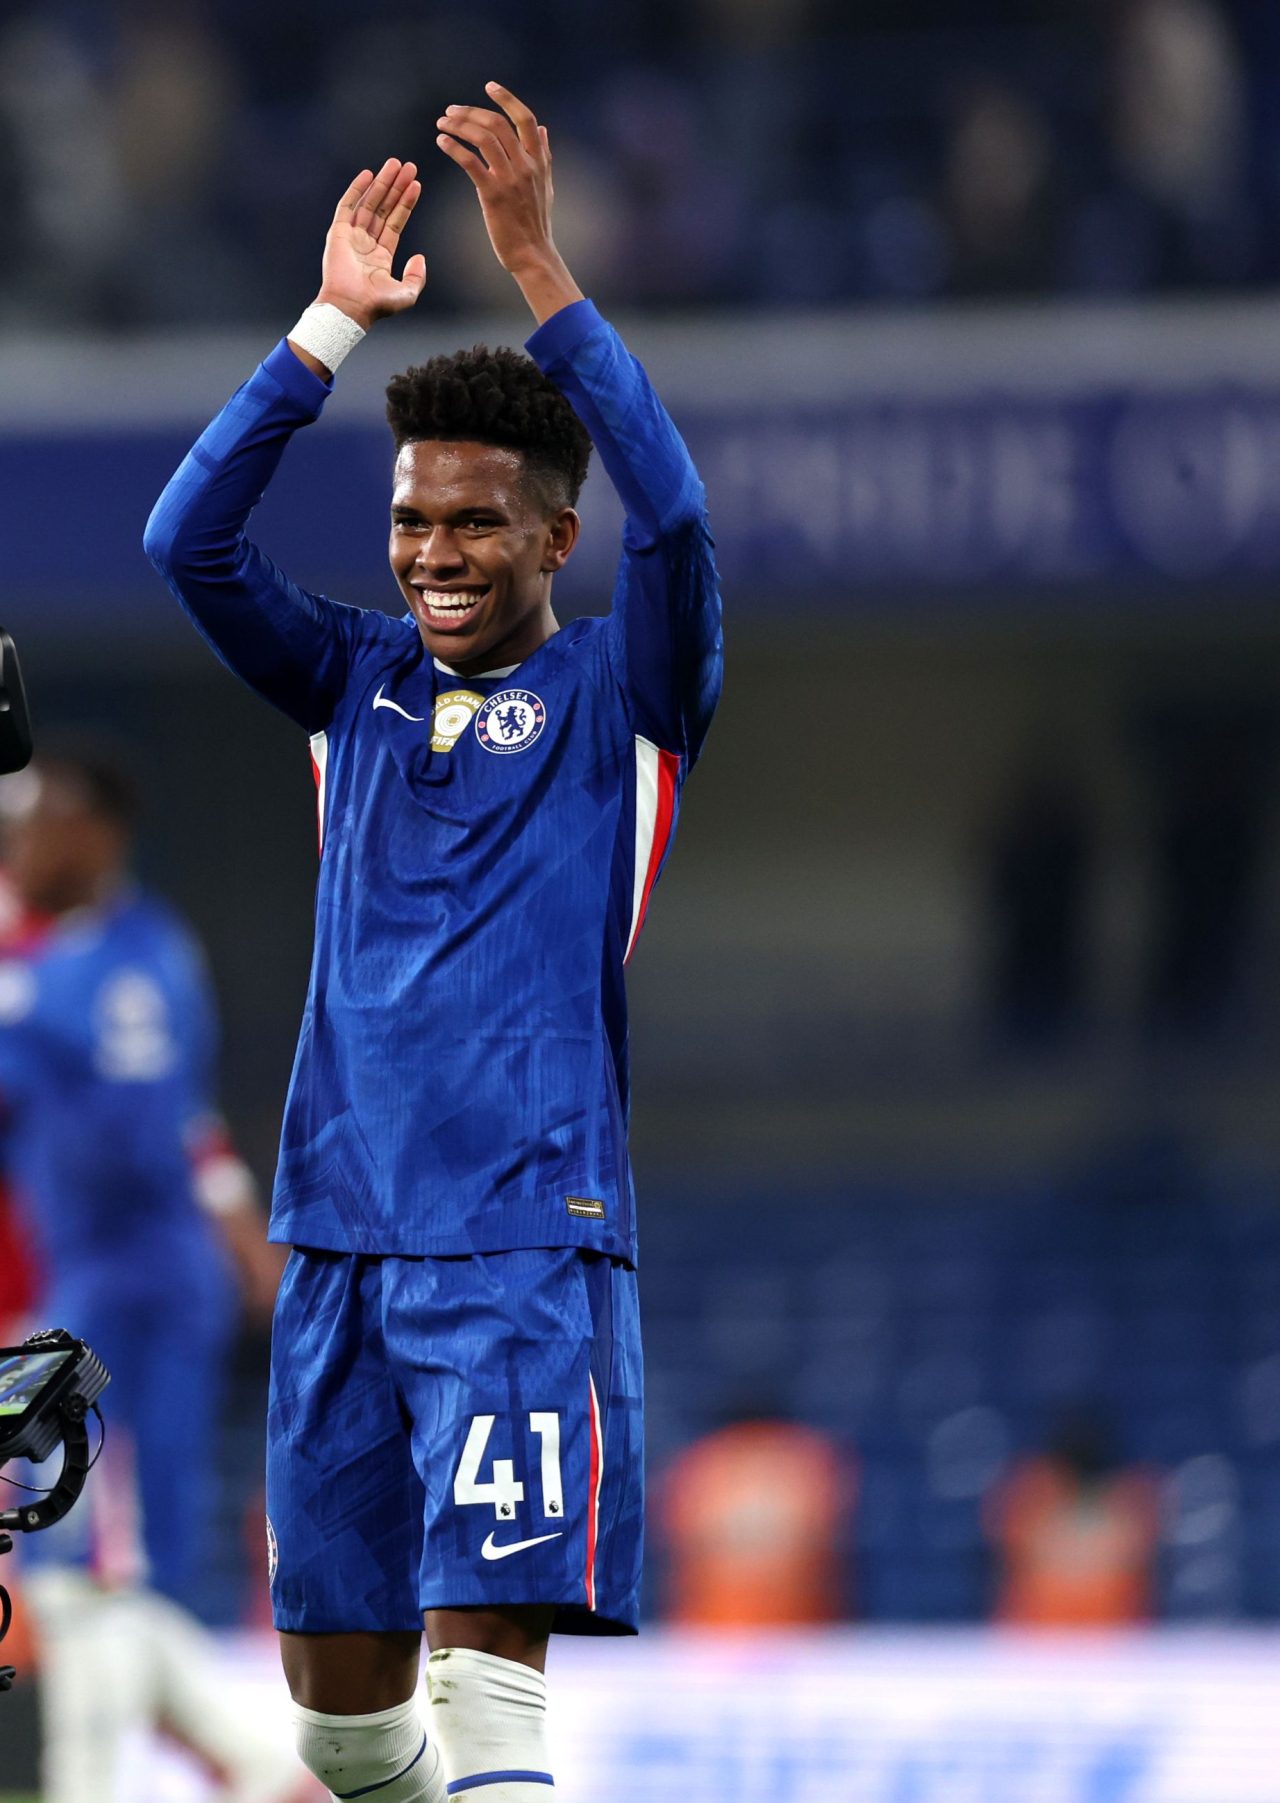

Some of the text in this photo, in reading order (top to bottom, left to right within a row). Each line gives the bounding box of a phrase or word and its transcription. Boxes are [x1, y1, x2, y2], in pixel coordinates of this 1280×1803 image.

[484, 692, 528, 713] CHELSEA
[429, 736, 455, 747] FIFA
[454, 1412, 564, 1520] 41
